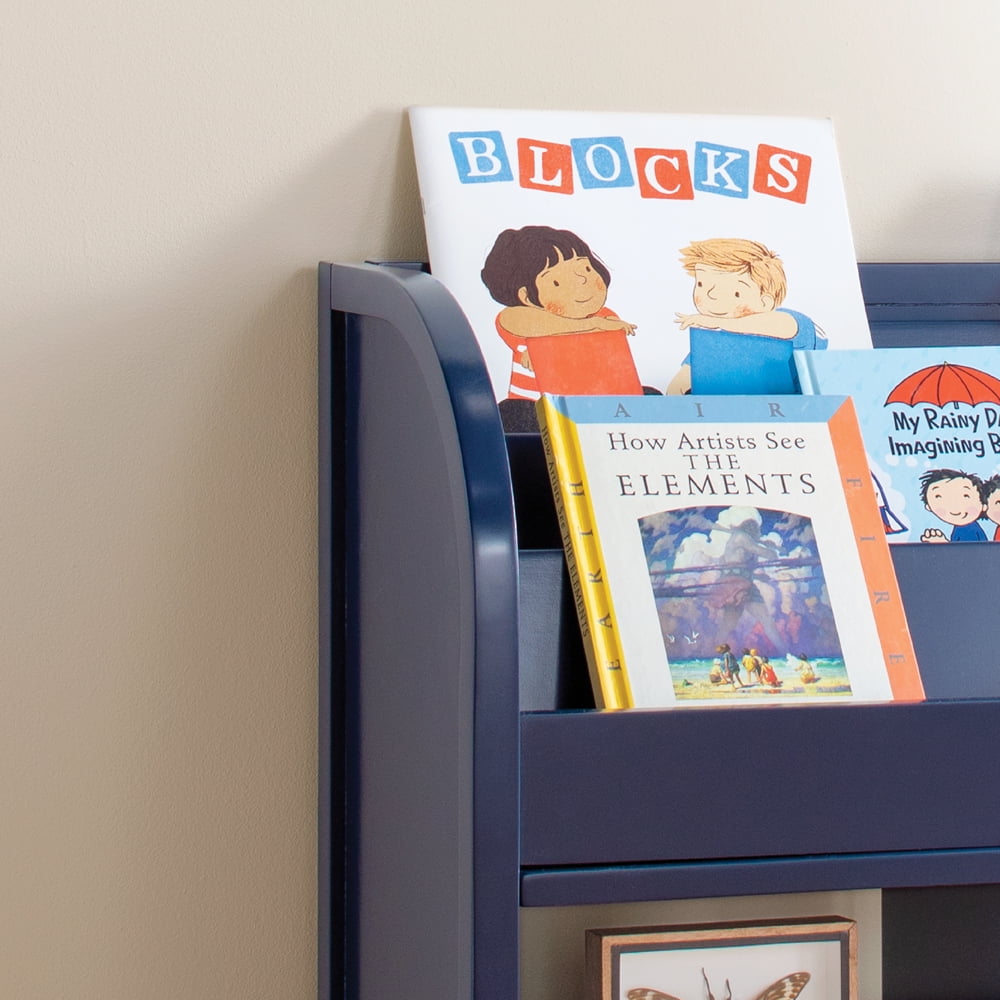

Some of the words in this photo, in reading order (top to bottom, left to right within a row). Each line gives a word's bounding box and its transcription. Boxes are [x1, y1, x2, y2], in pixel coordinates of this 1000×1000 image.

[455, 135, 802, 196] BLOCKS
[614, 402, 786, 419] AIR
[892, 411, 920, 434] My
[606, 432, 667, 451] How
[677, 431, 757, 451] Artists
[765, 431, 806, 450] See
[683, 453, 742, 471] THE
[616, 473, 817, 497] ELEMENTS
